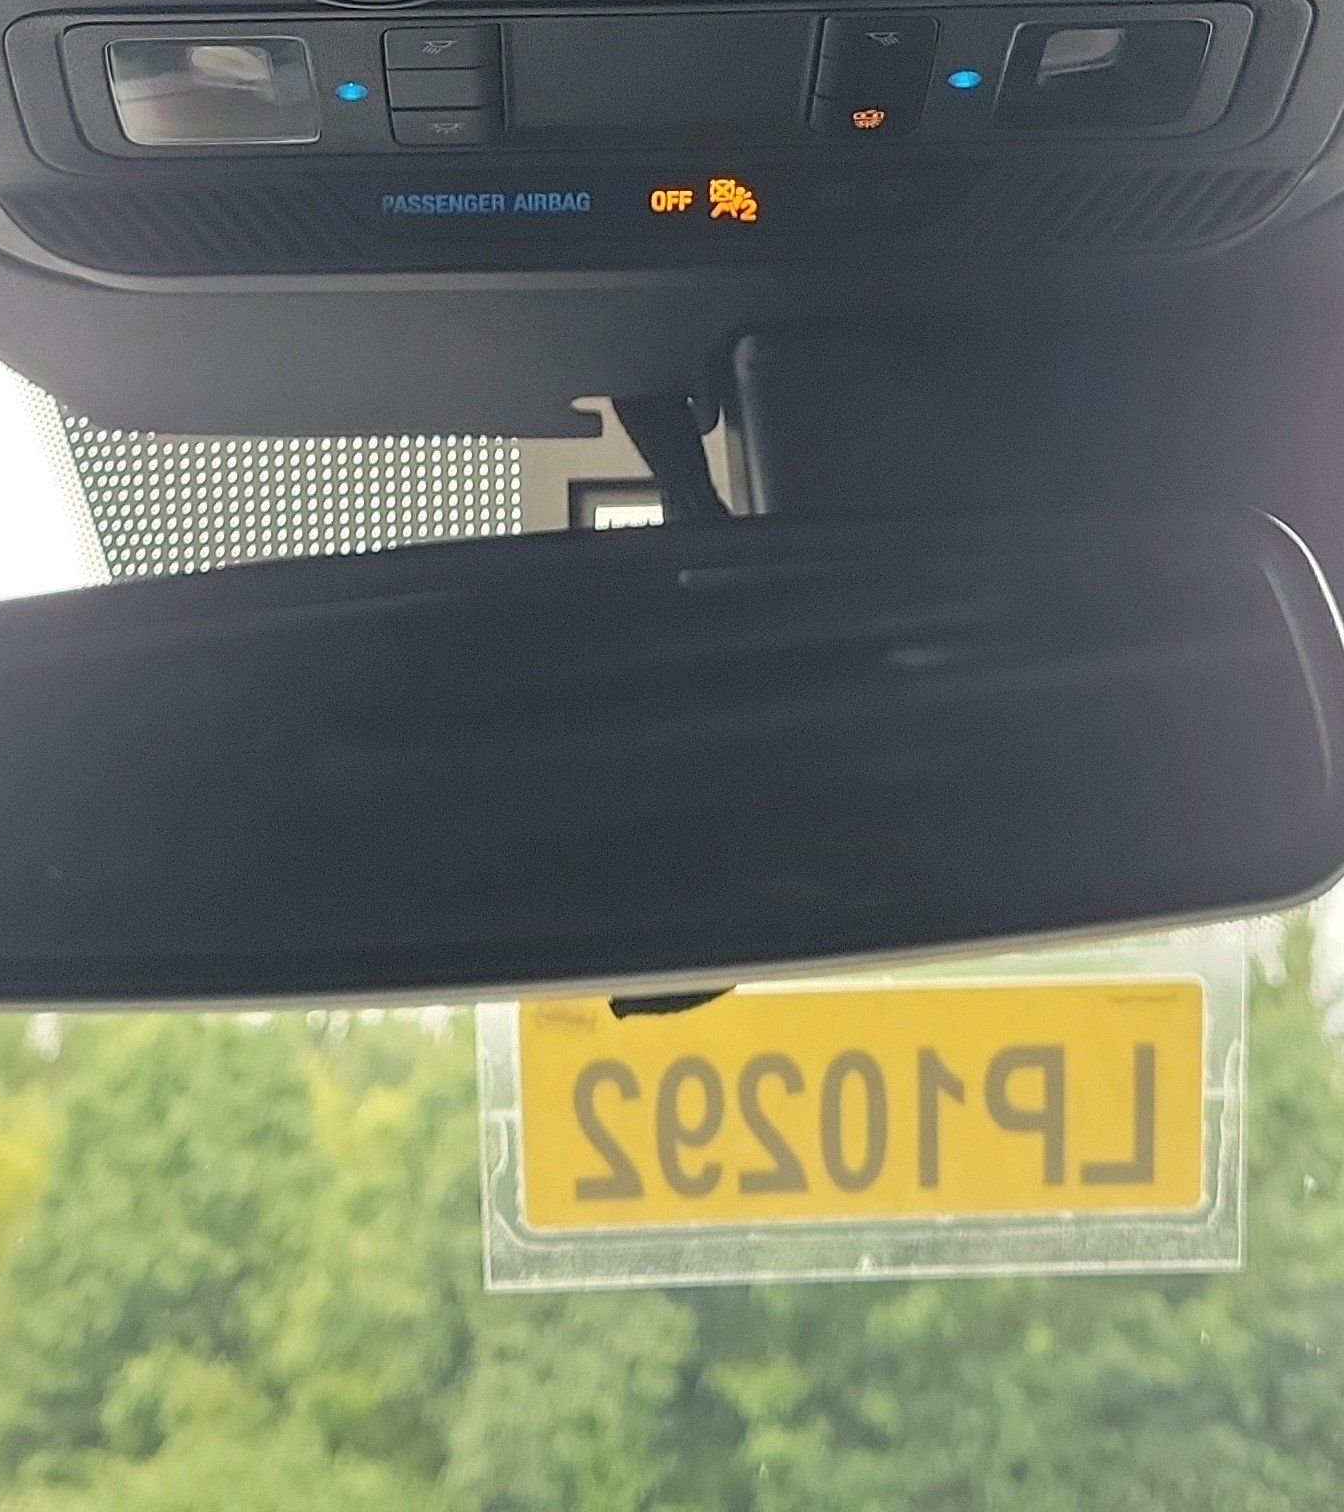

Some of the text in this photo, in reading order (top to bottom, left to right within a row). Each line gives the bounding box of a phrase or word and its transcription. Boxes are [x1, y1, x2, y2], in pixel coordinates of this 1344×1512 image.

[381, 190, 694, 214] PASSENGER AIRBAG OFF
